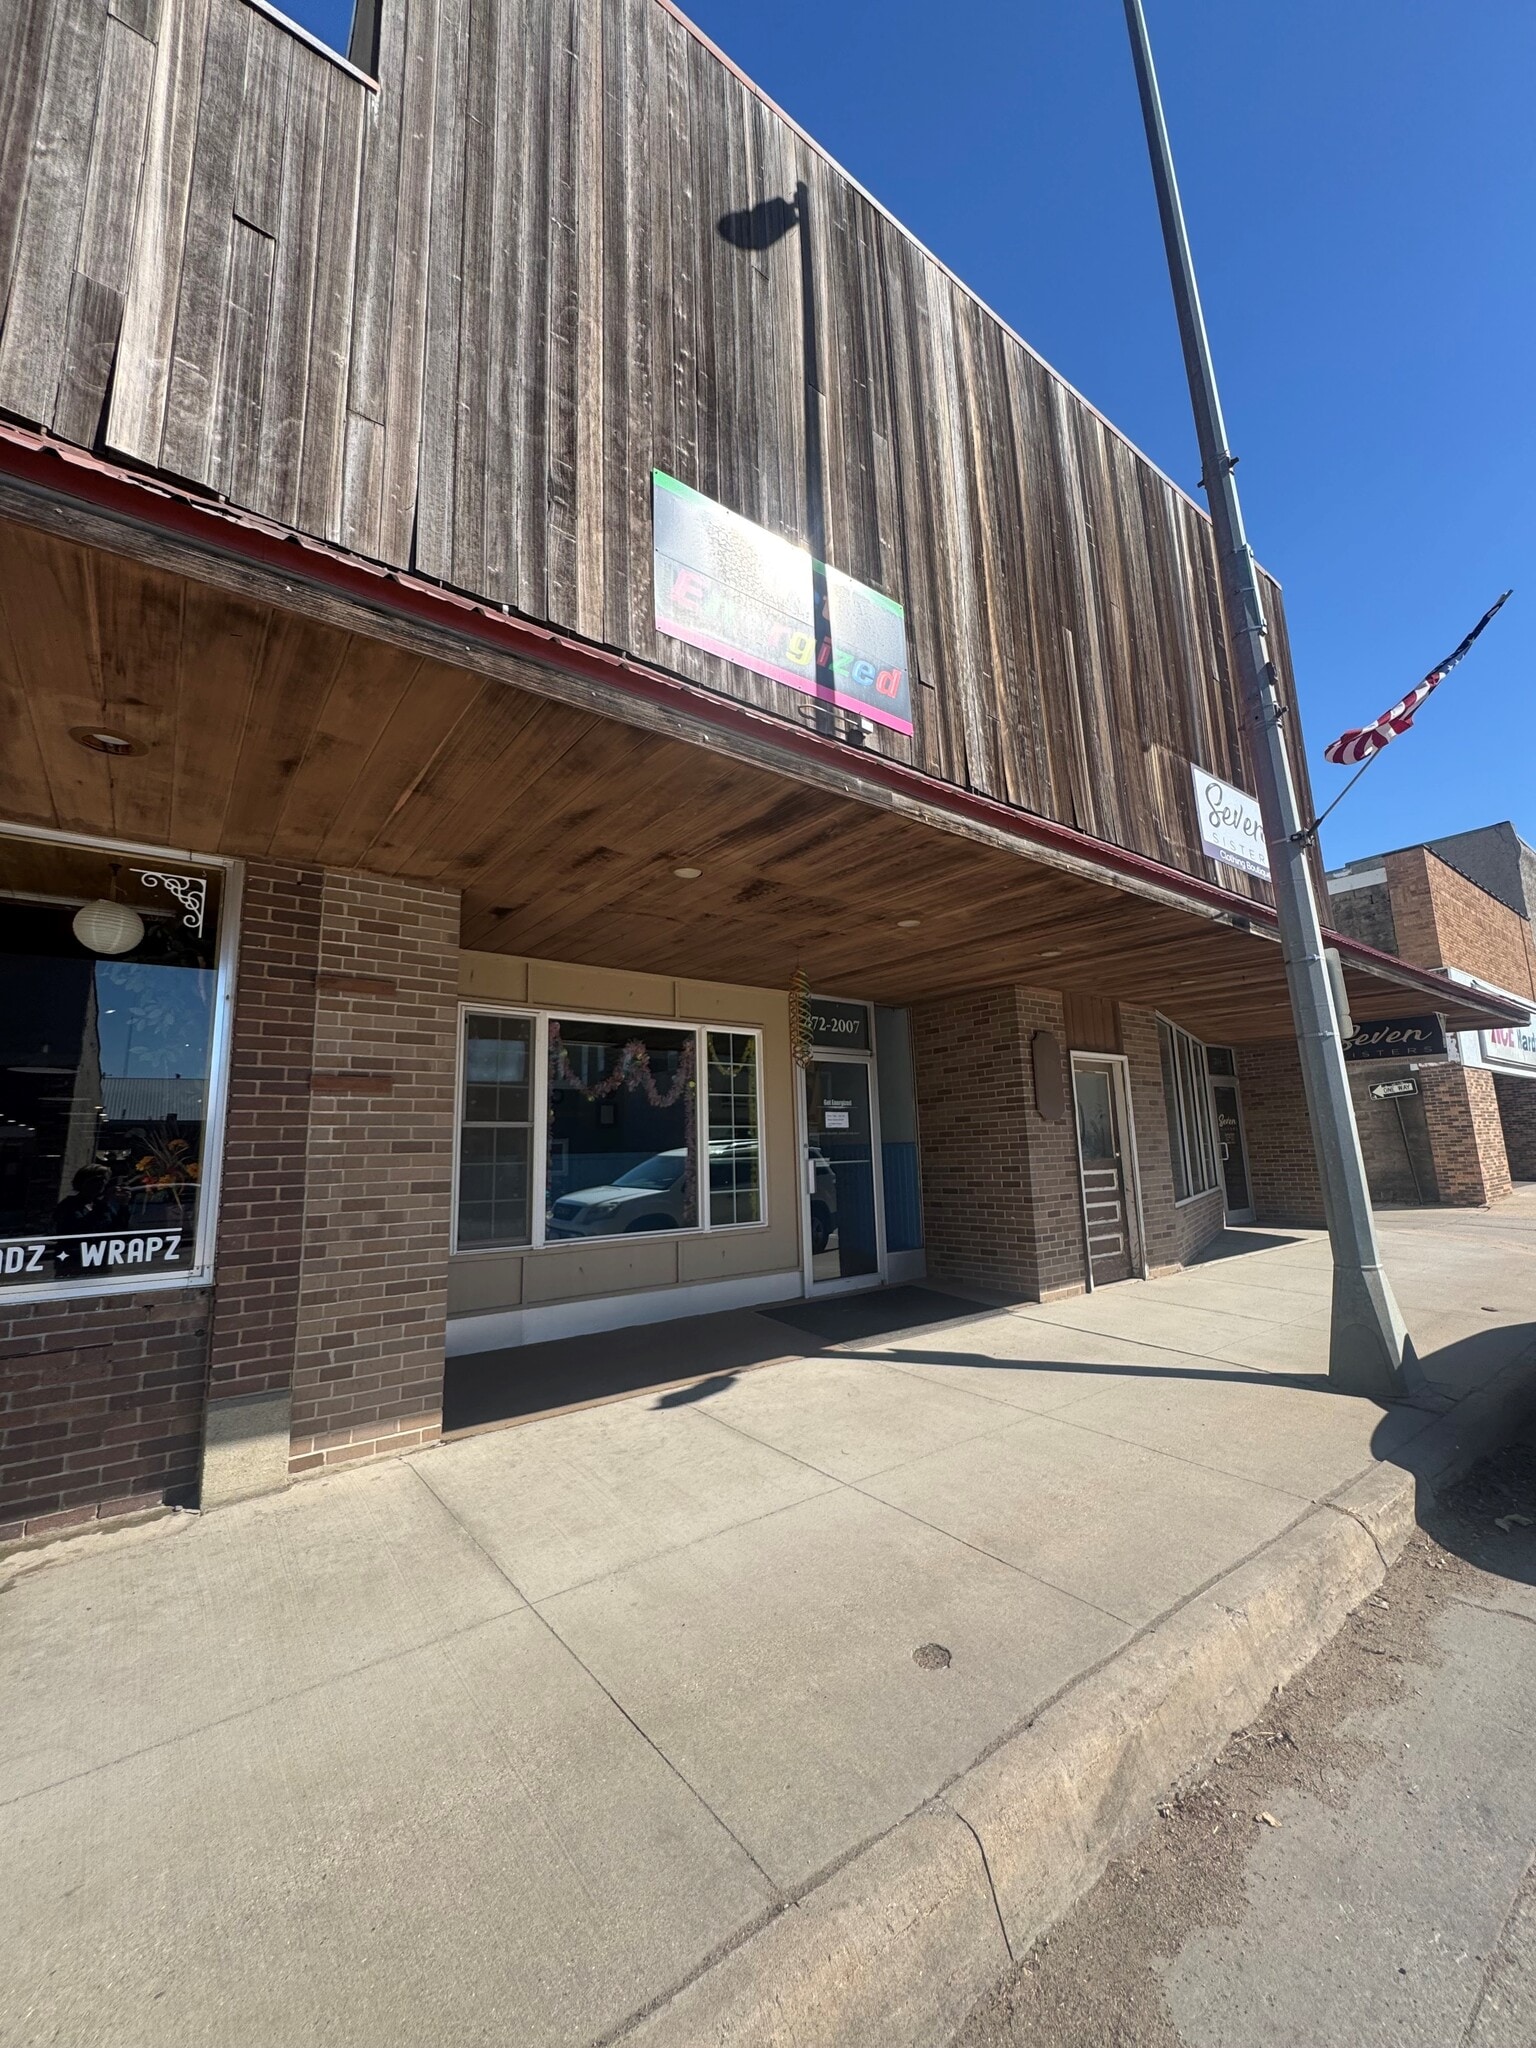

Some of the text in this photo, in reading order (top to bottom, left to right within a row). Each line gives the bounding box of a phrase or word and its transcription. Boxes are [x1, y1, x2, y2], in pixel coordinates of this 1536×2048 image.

[1205, 783, 1265, 843] Seven
[1212, 832, 1266, 865] SISTER
[804, 1015, 860, 1033] 72-2007
[1342, 1024, 1433, 1051] Seven
[1352, 1045, 1433, 1058] ISTERS
[80, 1235, 182, 1268] WRAPZ
